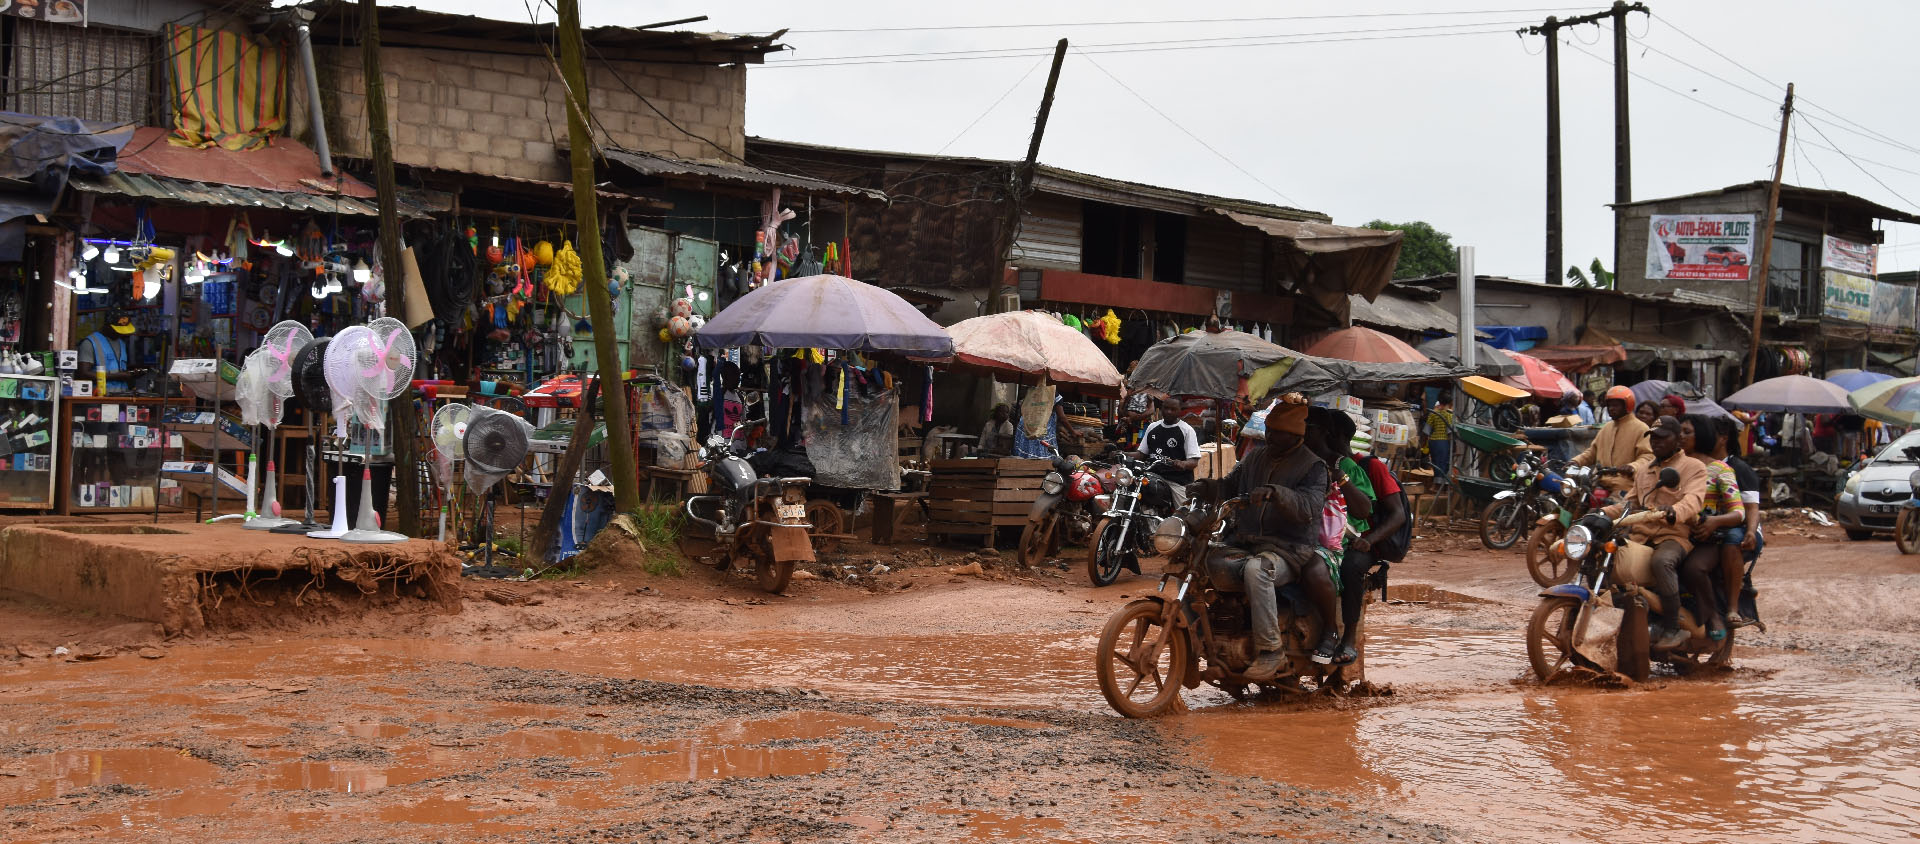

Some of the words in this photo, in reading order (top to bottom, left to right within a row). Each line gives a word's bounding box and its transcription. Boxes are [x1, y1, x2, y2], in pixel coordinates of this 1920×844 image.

[1675, 217, 1722, 236] AUTO-ÉCOLE
[1724, 221, 1750, 236] PILOTE
[1825, 286, 1870, 308] PILOTE
